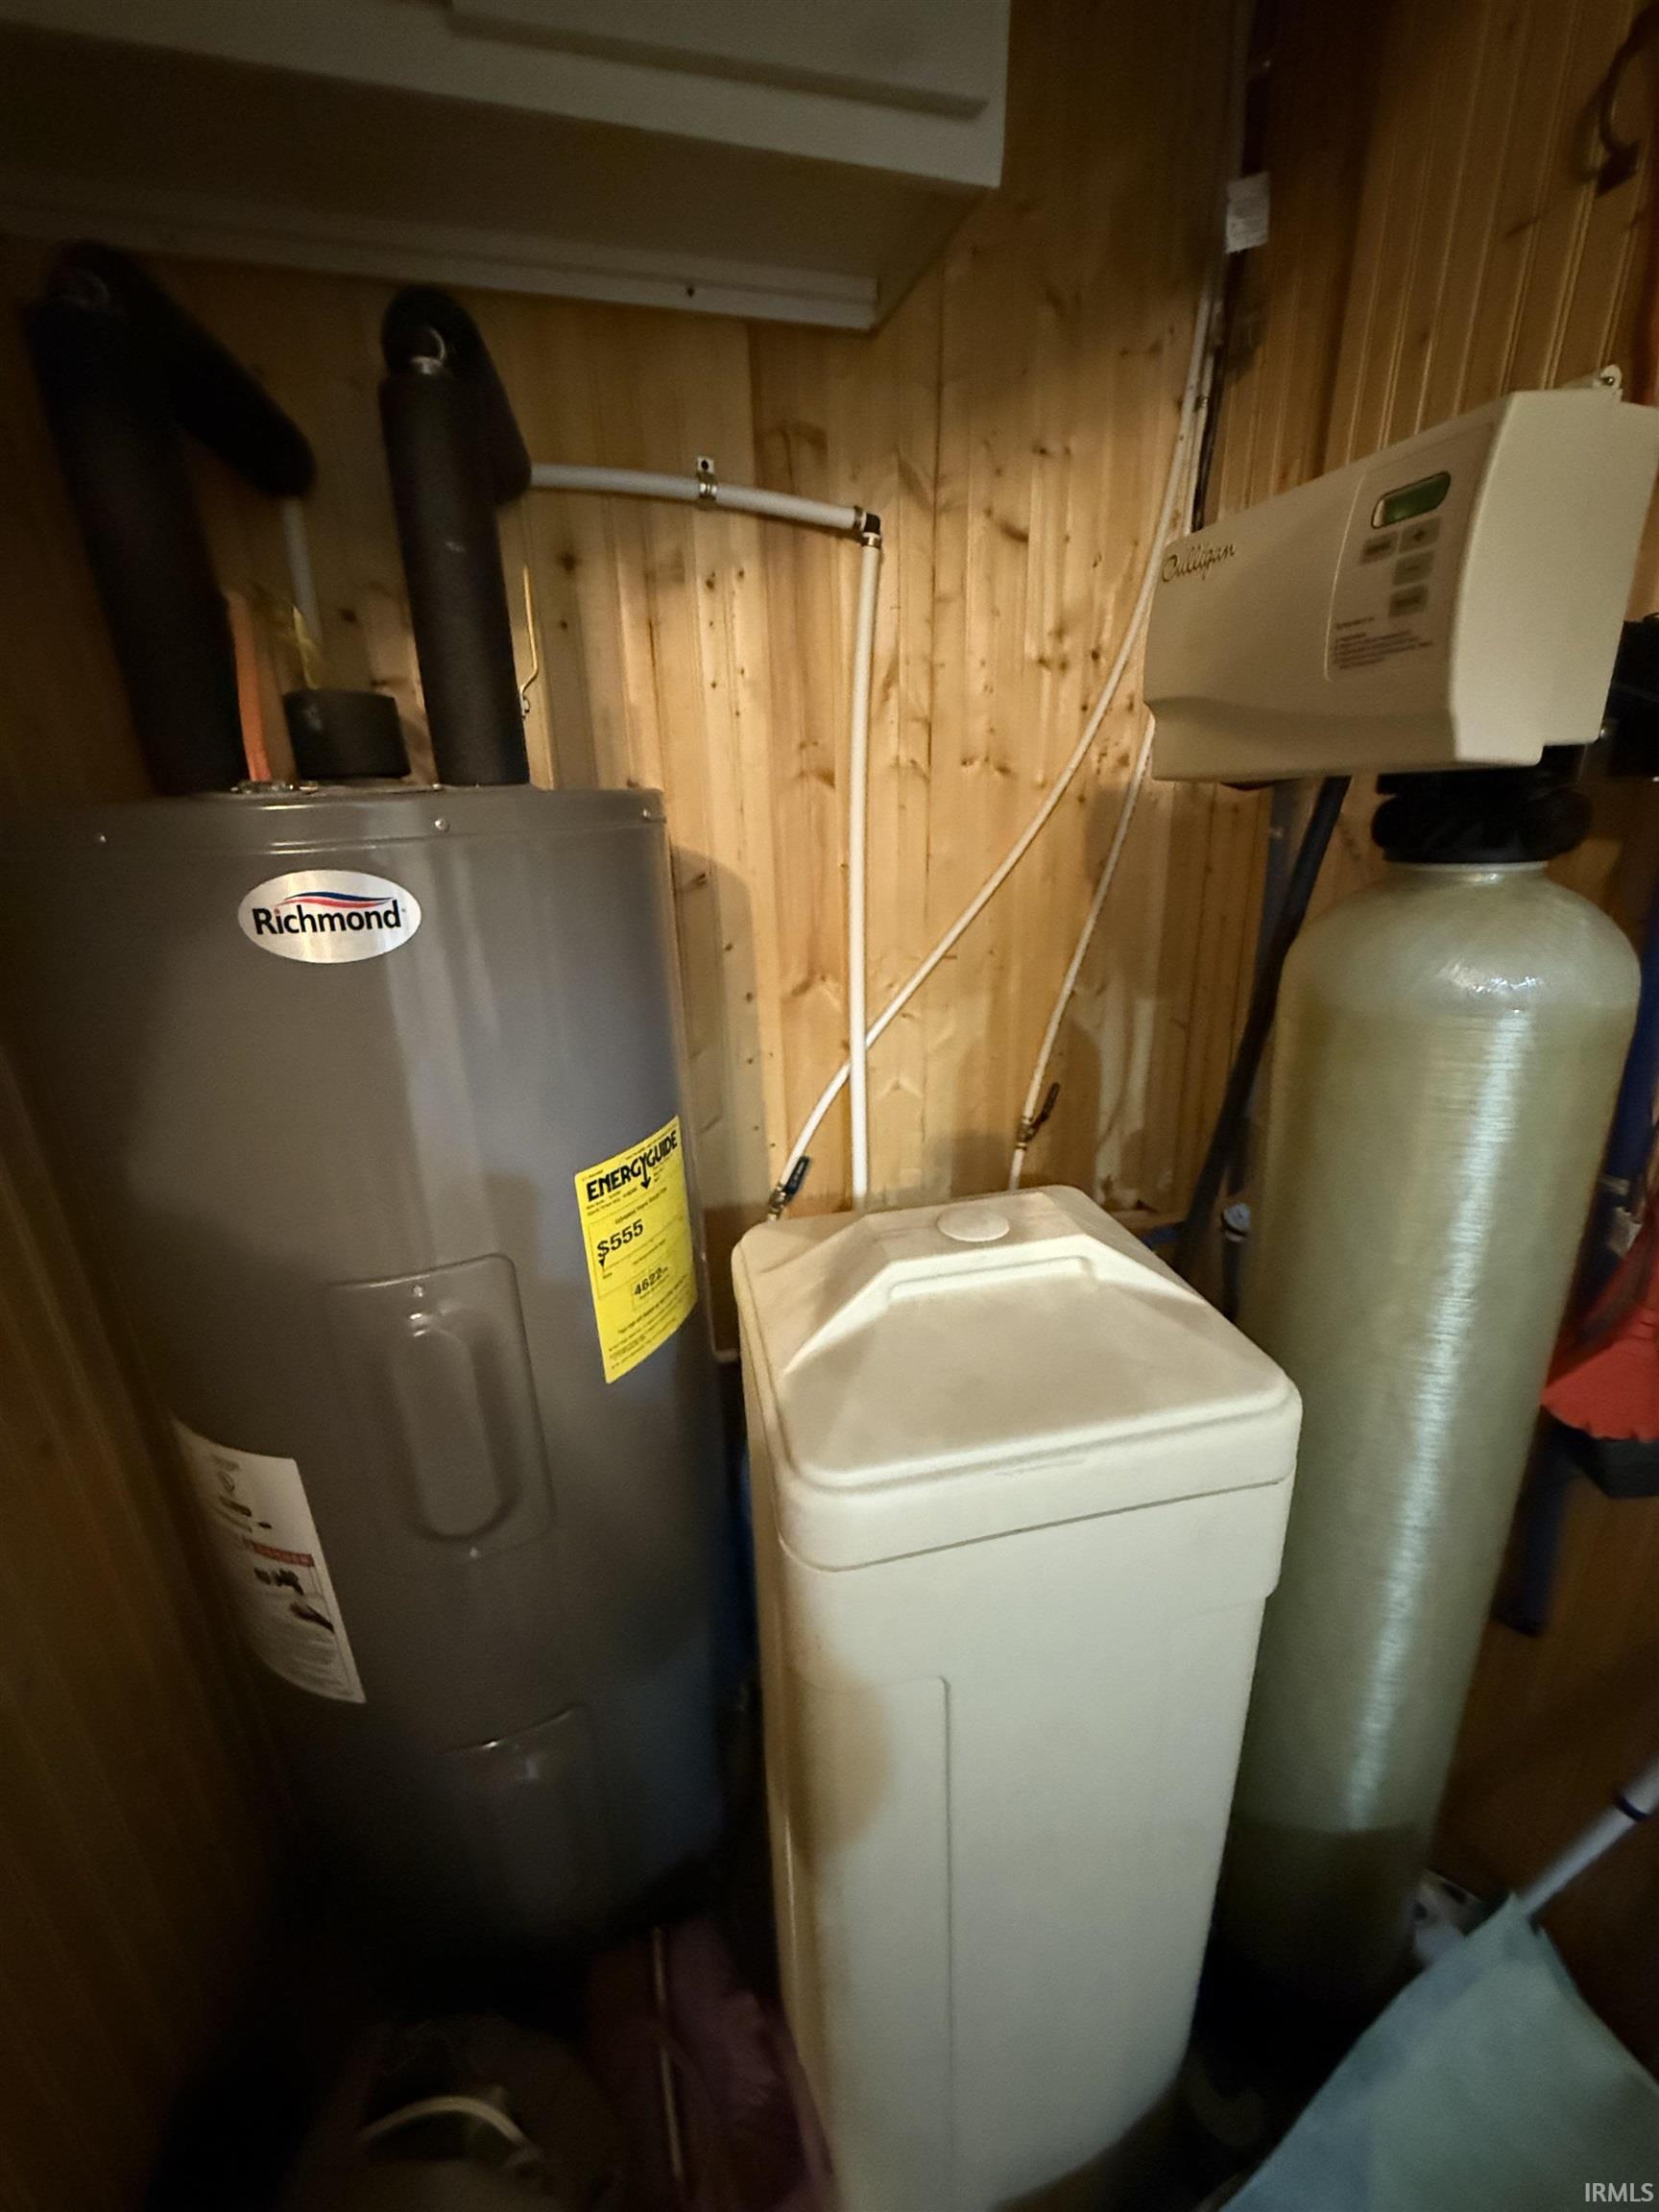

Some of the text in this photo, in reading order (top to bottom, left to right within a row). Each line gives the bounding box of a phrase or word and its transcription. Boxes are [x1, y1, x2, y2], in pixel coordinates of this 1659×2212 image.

[1162, 543, 1236, 583] Culligan
[252, 899, 401, 935] Richmond
[586, 1129, 678, 1202] ENERGYGUIDE
[596, 1217, 644, 1260] $555
[634, 1267, 662, 1296] 4622
